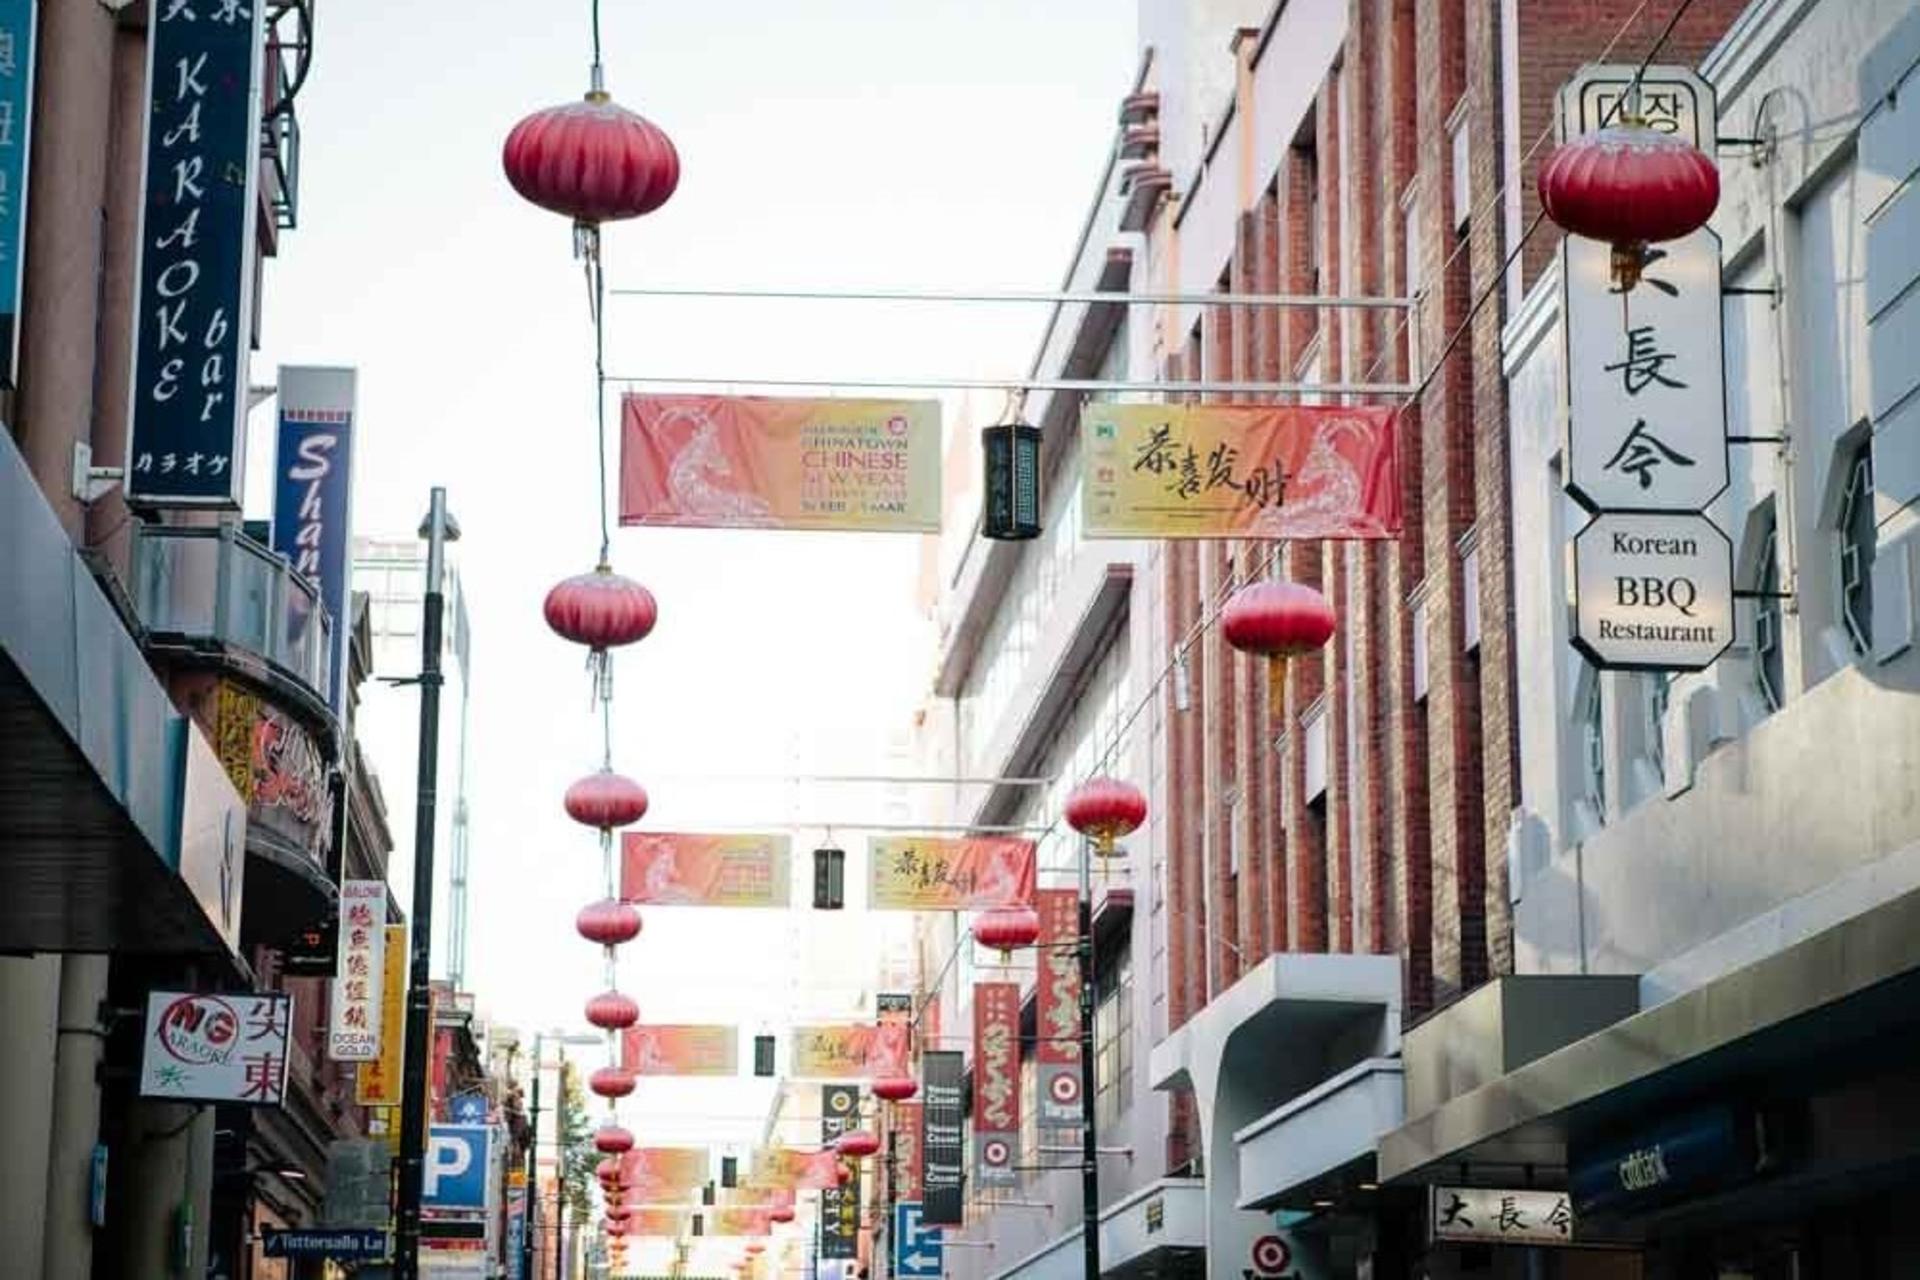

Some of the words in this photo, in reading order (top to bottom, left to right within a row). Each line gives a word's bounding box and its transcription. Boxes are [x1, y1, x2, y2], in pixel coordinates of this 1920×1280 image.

[152, 52, 209, 401] KARAOKE
[200, 307, 228, 422] bar
[133, 450, 230, 476] カラオケ
[801, 451, 909, 469] CHINESE
[1612, 532, 1698, 556] Korean
[1614, 576, 1698, 617] BBQ
[1599, 619, 1717, 643] Restaurant
[332, 1033, 376, 1044] OCEAN
[335, 1044, 371, 1056] GOLD
[423, 1136, 472, 1197] P
